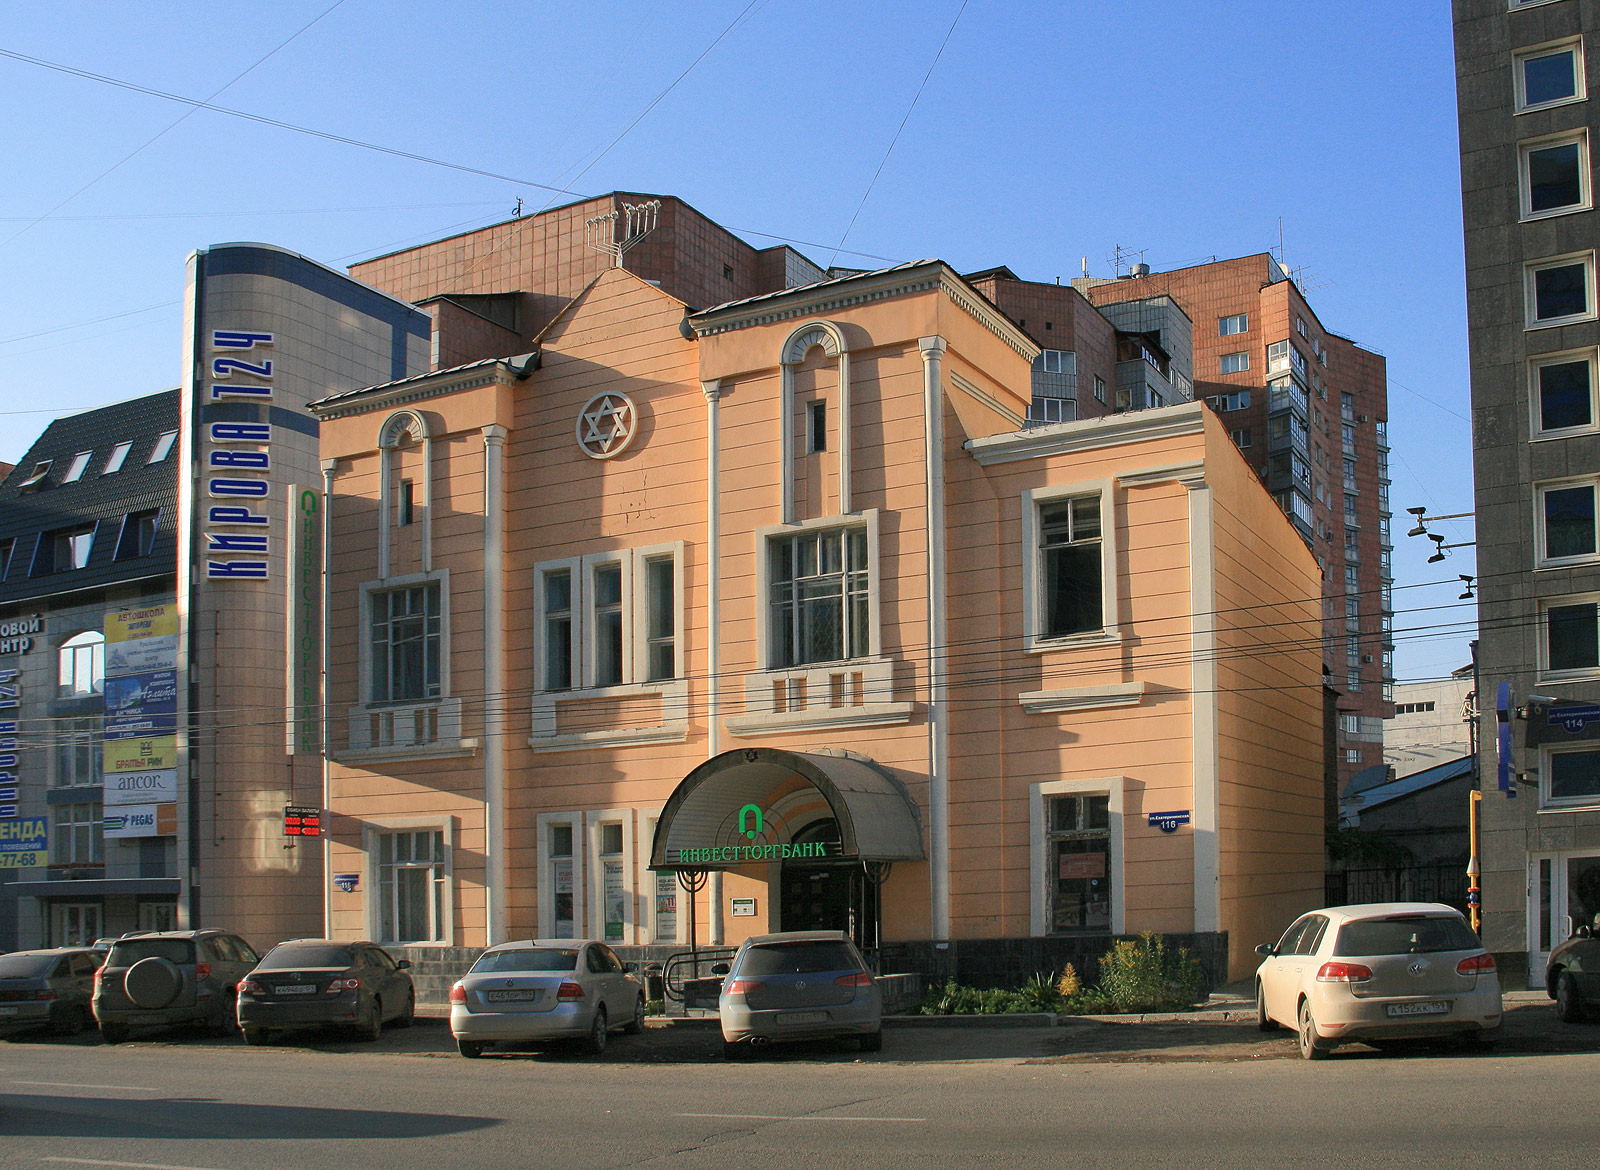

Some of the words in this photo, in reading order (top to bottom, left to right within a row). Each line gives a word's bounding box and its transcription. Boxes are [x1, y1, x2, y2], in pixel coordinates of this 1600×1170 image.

[212, 330, 274, 400] 124
[206, 421, 272, 580] КИРОВА
[117, 608, 165, 623] АВТОШКОЛА
[1565, 719, 1583, 728] 114
[118, 774, 167, 790] ancor
[131, 814, 154, 826] PEGAS
[1160, 820, 1176, 829] 116
[679, 842, 827, 863] ИНВЕСТТОРГБАНК
